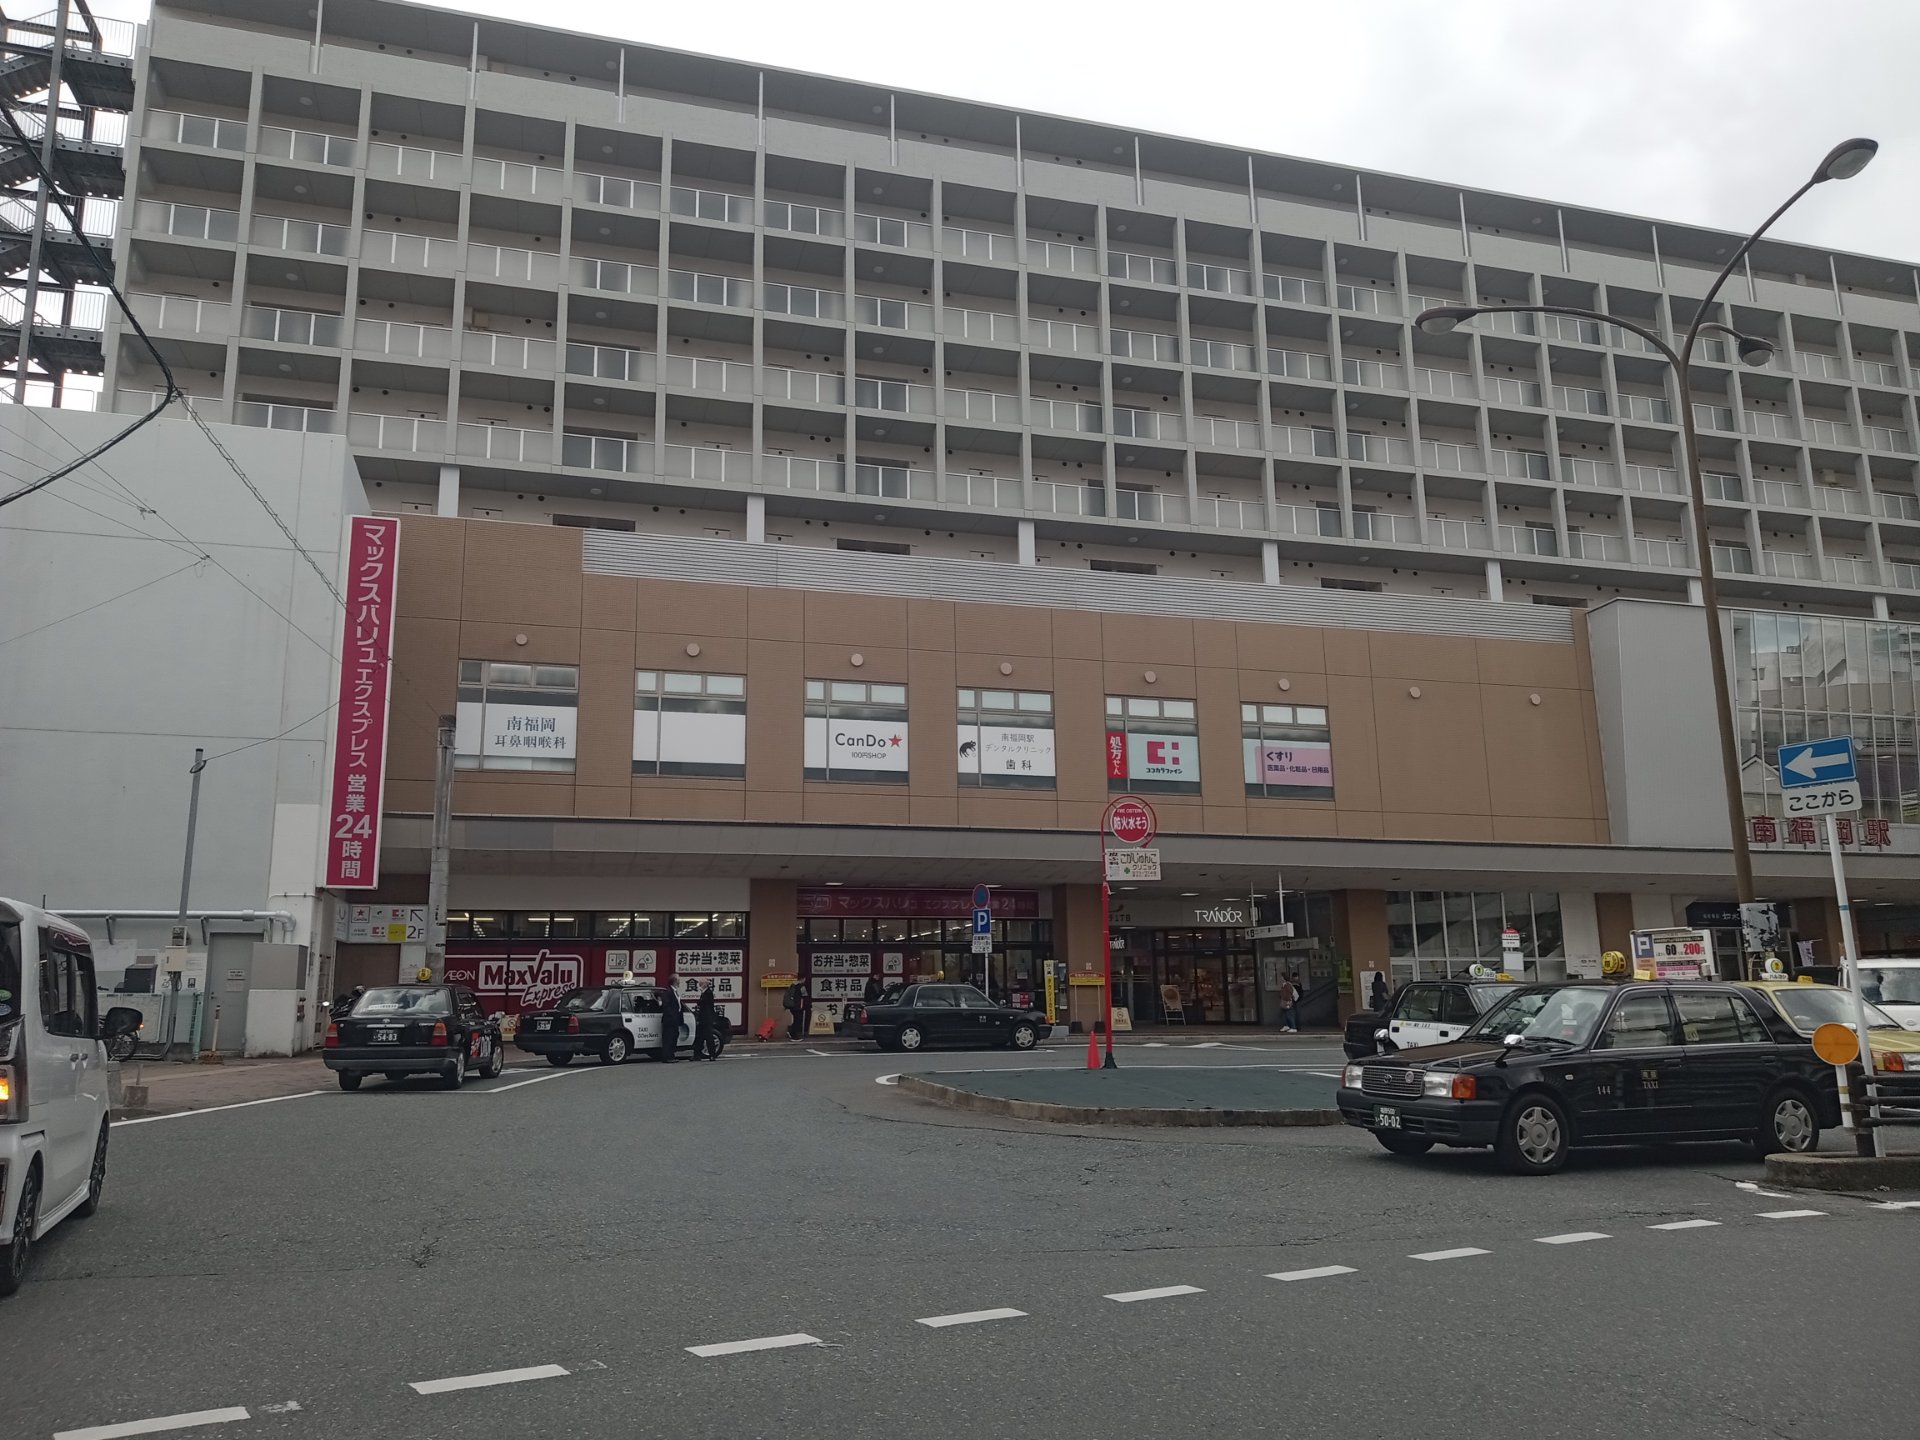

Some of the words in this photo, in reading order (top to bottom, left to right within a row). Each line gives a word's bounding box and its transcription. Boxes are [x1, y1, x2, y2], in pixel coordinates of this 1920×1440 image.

[506, 715, 556, 733] 南福岡
[494, 734, 567, 750] 耳鼻咽喉科
[835, 732, 886, 748] CanDo
[1000, 733, 1035, 743] 南福岡駅
[985, 743, 1051, 754] デンタルクリニック
[1109, 736, 1123, 776] 処方せん
[1266, 751, 1293, 762] くすり
[1789, 789, 1854, 812] ここから
[1113, 816, 1147, 831] 防火水そう
[977, 911, 988, 932] P
[407, 925, 425, 939] 2F
[1636, 936, 1650, 956] P
[677, 951, 741, 966] お弁当・惣菜
[813, 954, 870, 968] お弁当・惣菜
[484, 951, 574, 986] MaxValu
[820, 978, 863, 992] 食料品
[522, 982, 577, 1007] Express
